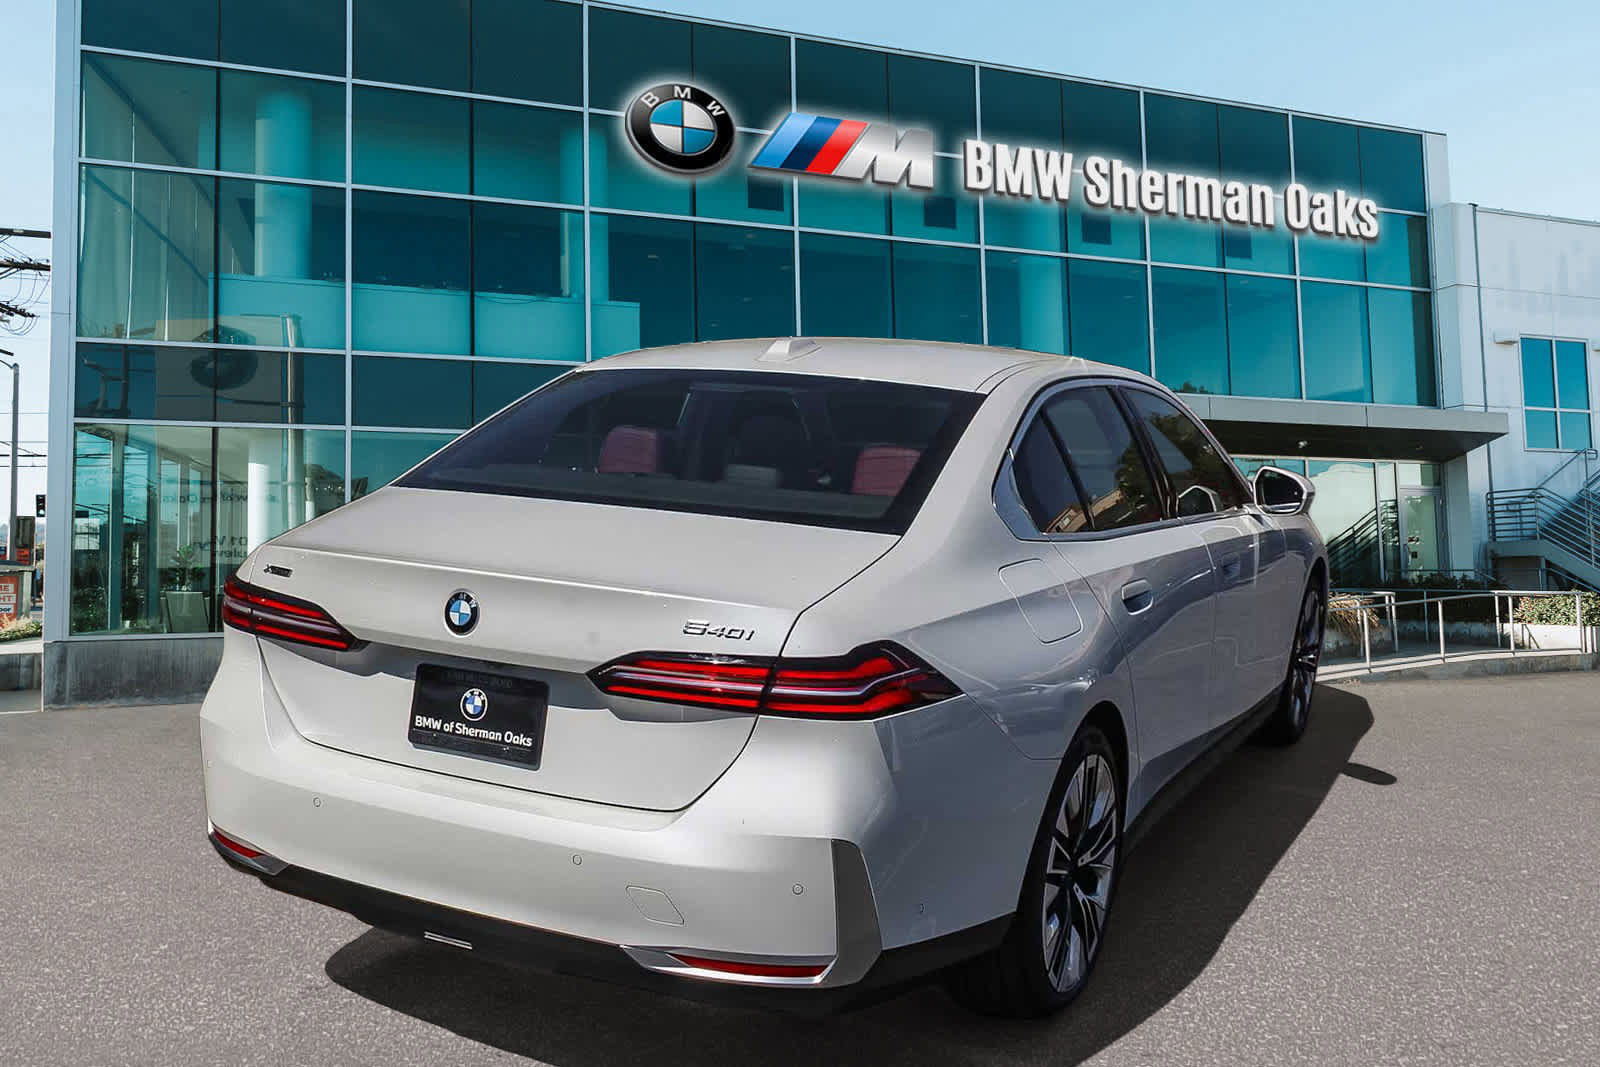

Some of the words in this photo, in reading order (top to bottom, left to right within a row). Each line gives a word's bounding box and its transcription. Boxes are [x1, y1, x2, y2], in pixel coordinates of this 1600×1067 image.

[641, 85, 725, 117] BMW
[963, 139, 1073, 201] BMW
[1083, 155, 1275, 226] Sherman
[1283, 182, 1380, 240] Oaks
[415, 715, 442, 731] BMW
[443, 721, 454, 733] of
[455, 722, 502, 742] Sherman
[504, 731, 533, 747] Oaks
